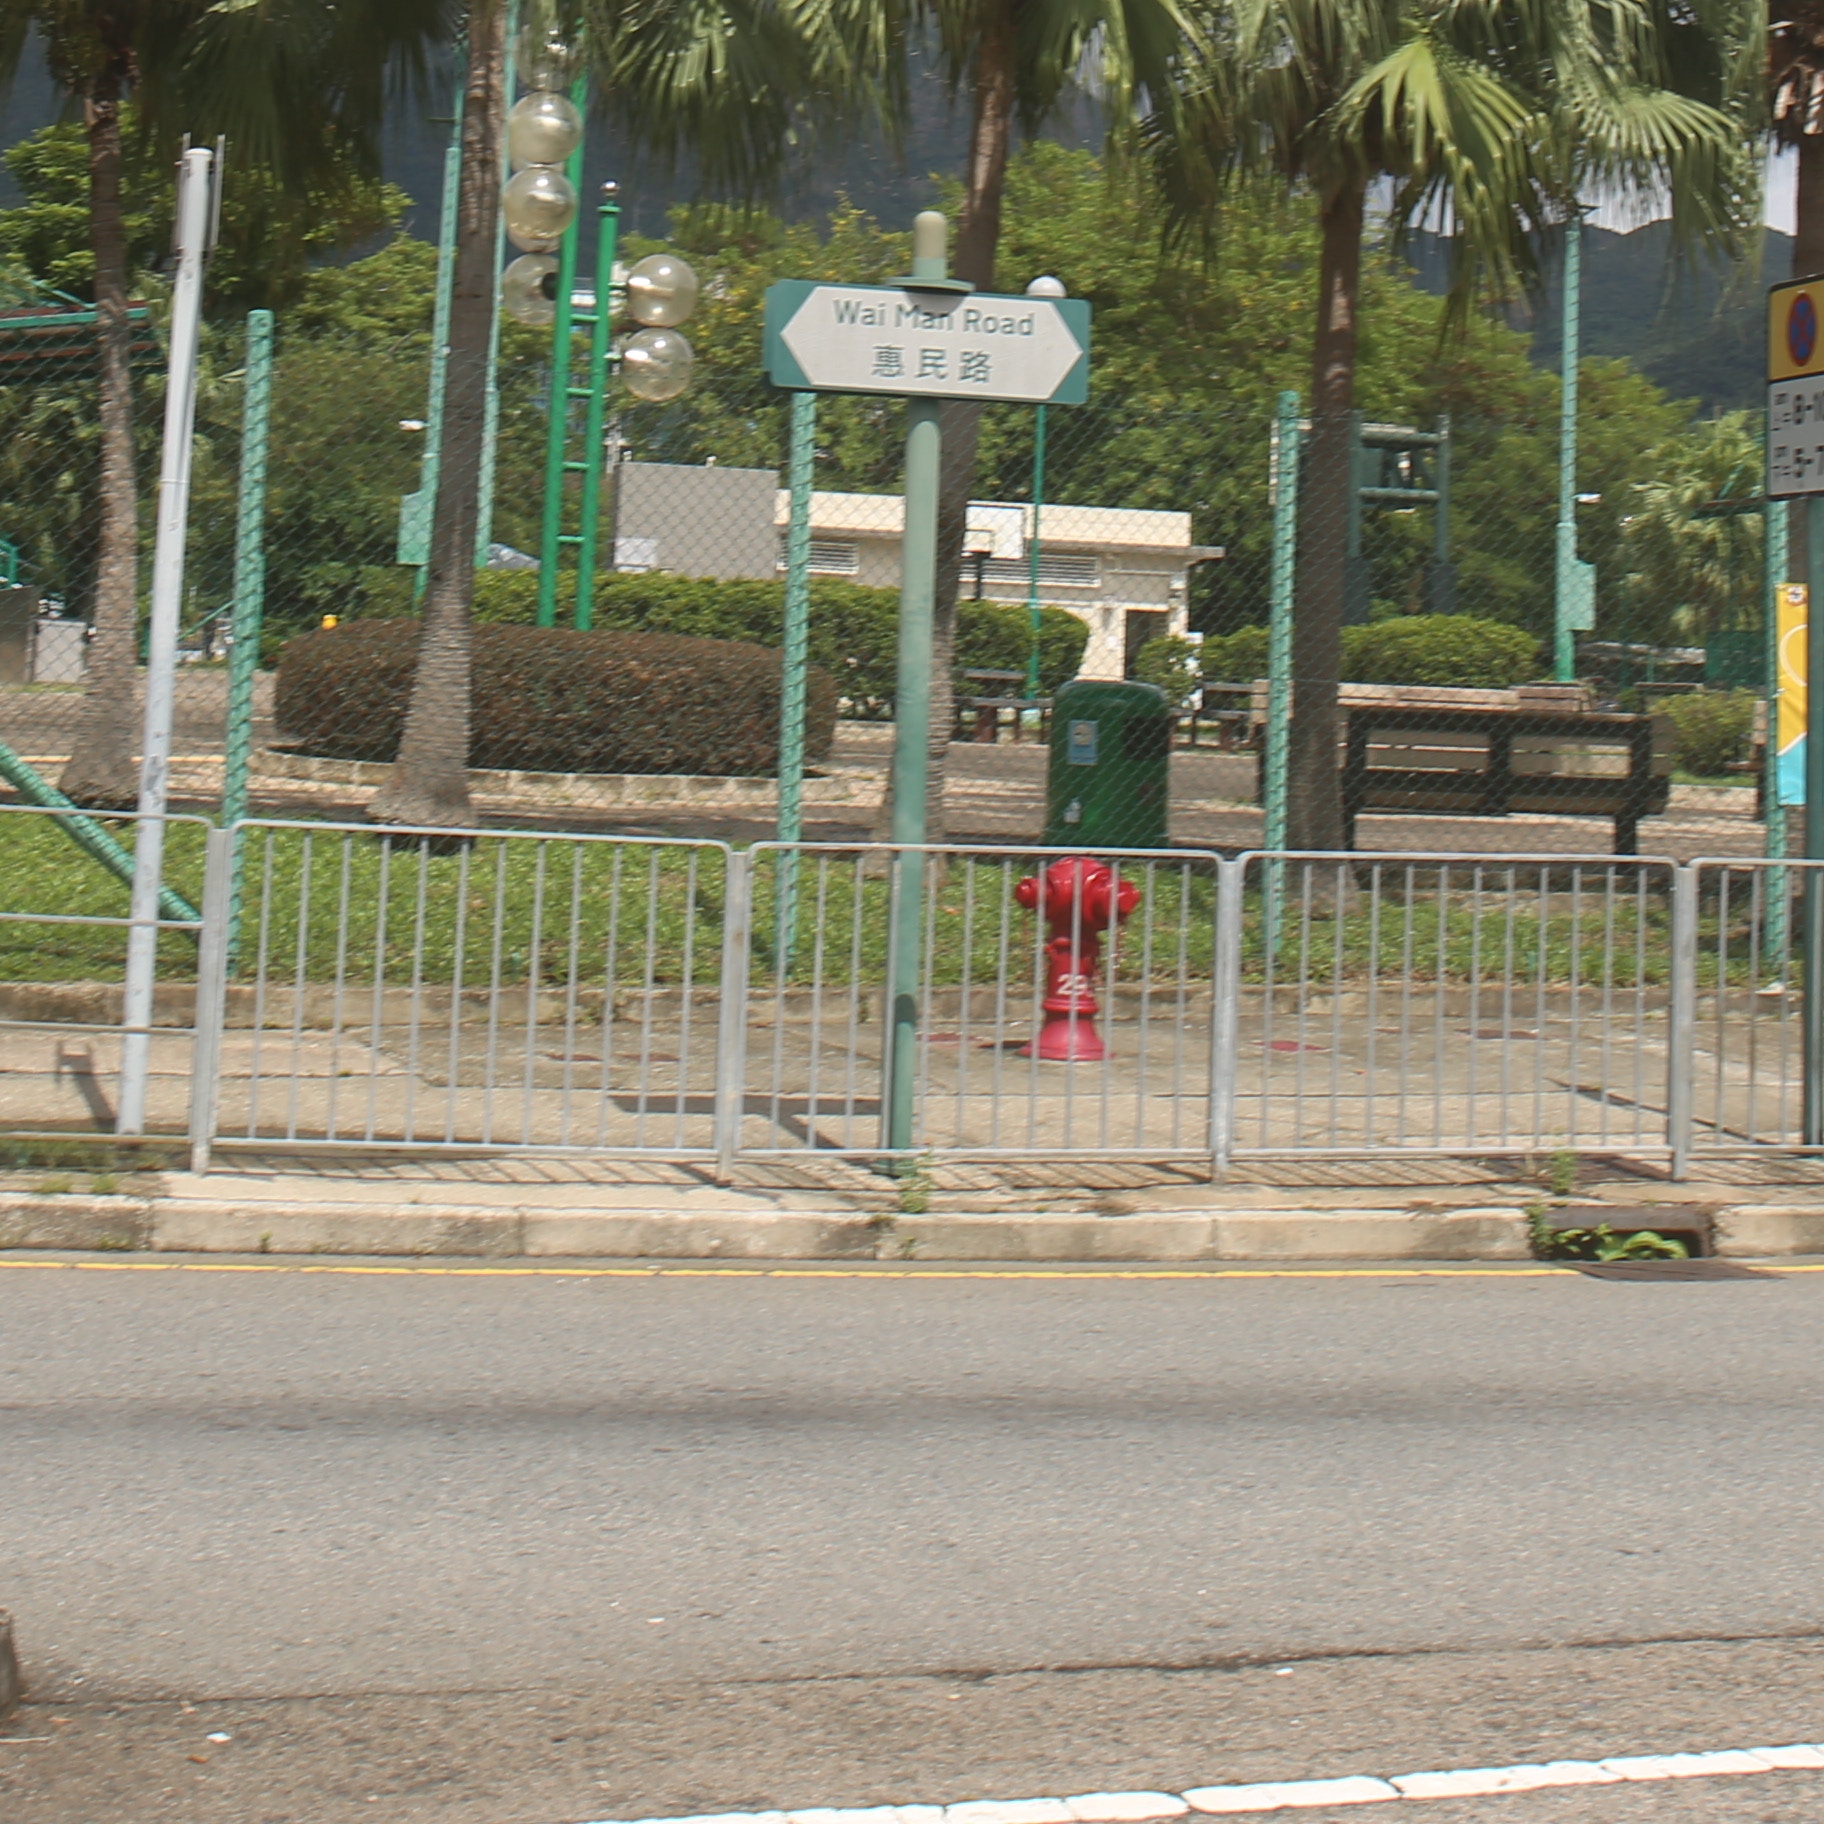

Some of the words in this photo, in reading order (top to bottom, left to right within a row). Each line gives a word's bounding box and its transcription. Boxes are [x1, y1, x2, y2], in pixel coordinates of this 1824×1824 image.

[832, 298, 886, 327] Wai
[895, 303, 954, 332] Man
[963, 308, 1035, 337] Road
[871, 343, 992, 384] 惠民路
